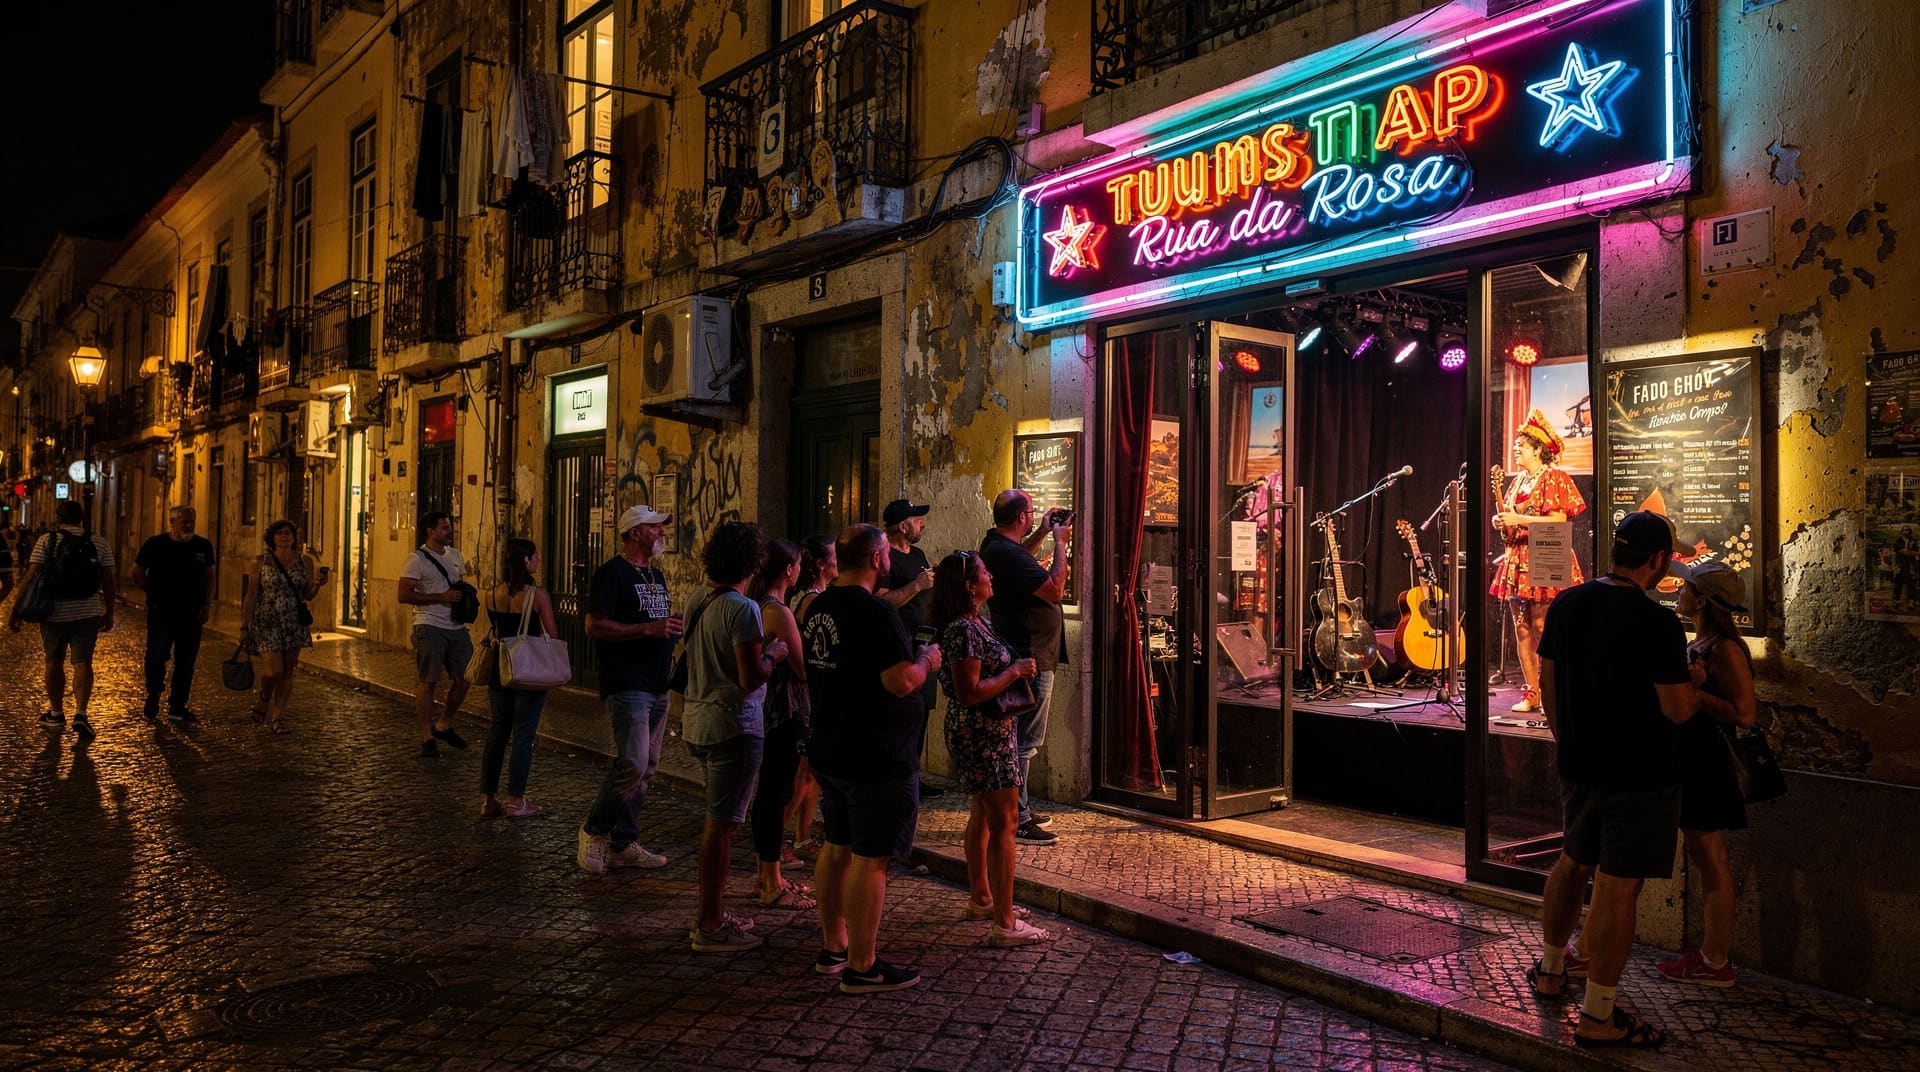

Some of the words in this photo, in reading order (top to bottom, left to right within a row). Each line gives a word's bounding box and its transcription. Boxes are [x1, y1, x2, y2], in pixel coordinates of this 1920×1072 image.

[1128, 214, 1220, 266] Rua
[1229, 186, 1292, 242] da
[1301, 155, 1454, 224] Rosa
[1633, 380, 1668, 405] FADO
